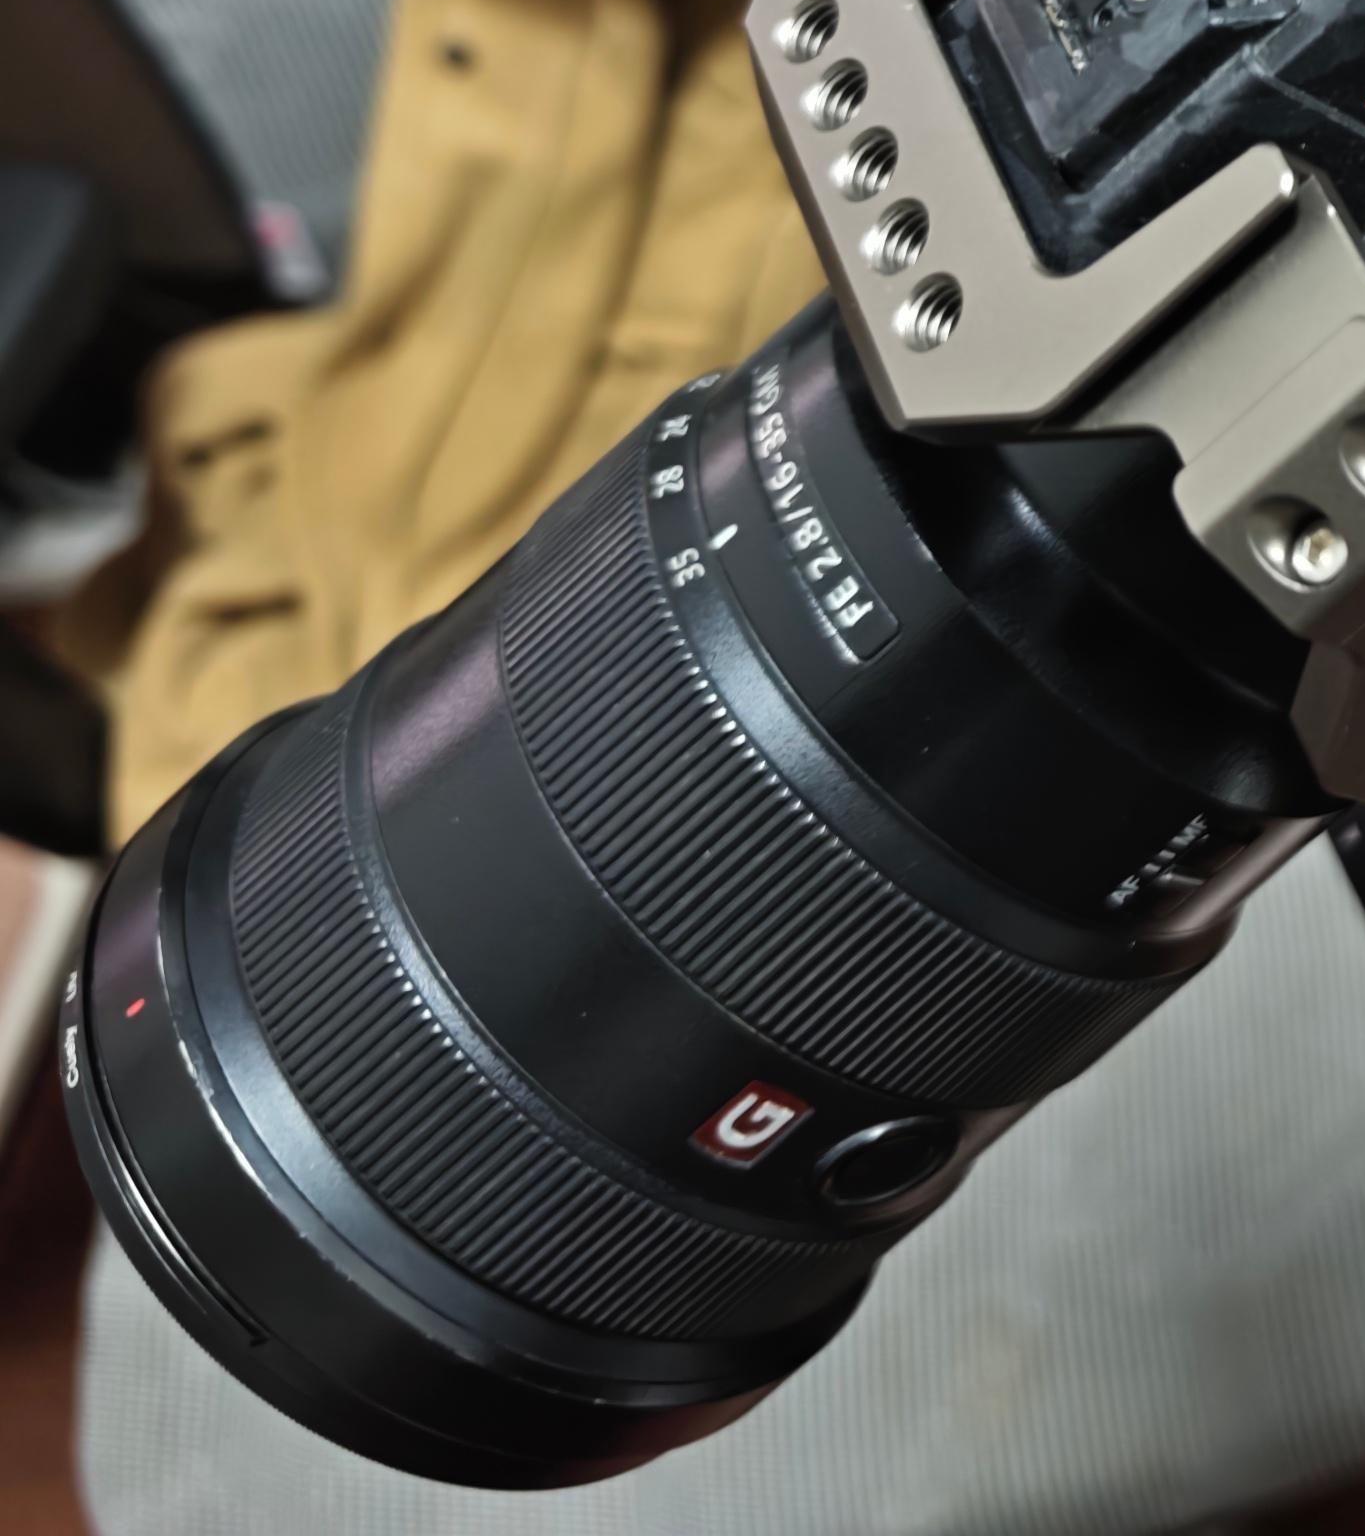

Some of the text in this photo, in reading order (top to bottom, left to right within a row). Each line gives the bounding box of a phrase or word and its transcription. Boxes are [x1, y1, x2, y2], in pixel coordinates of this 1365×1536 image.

[651, 465, 684, 500] 28
[753, 412, 843, 581] 2.8/16-35
[665, 547, 705, 588] 35
[825, 575, 874, 628] FE
